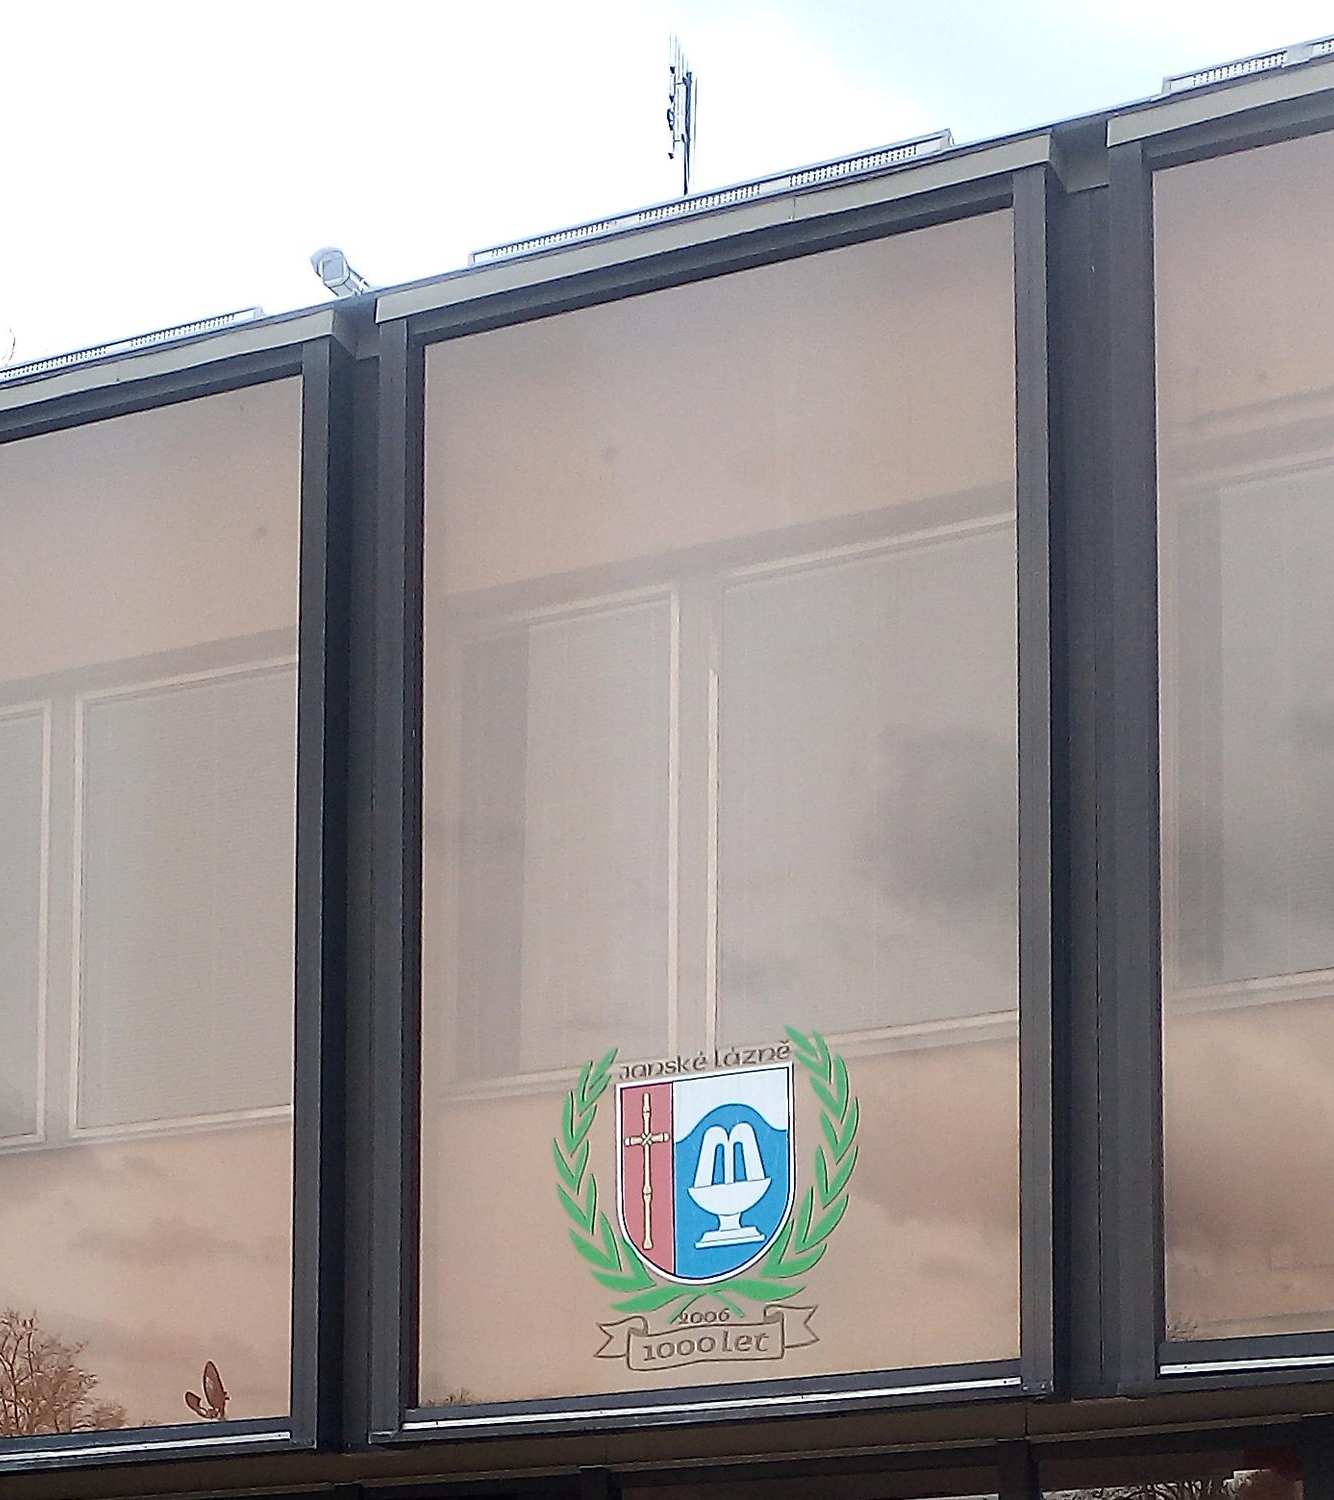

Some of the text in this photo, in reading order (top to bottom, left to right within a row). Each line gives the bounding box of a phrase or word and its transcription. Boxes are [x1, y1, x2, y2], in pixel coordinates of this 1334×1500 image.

[679, 1308, 731, 1324] 2006
[643, 1331, 770, 1361] 1000 let
